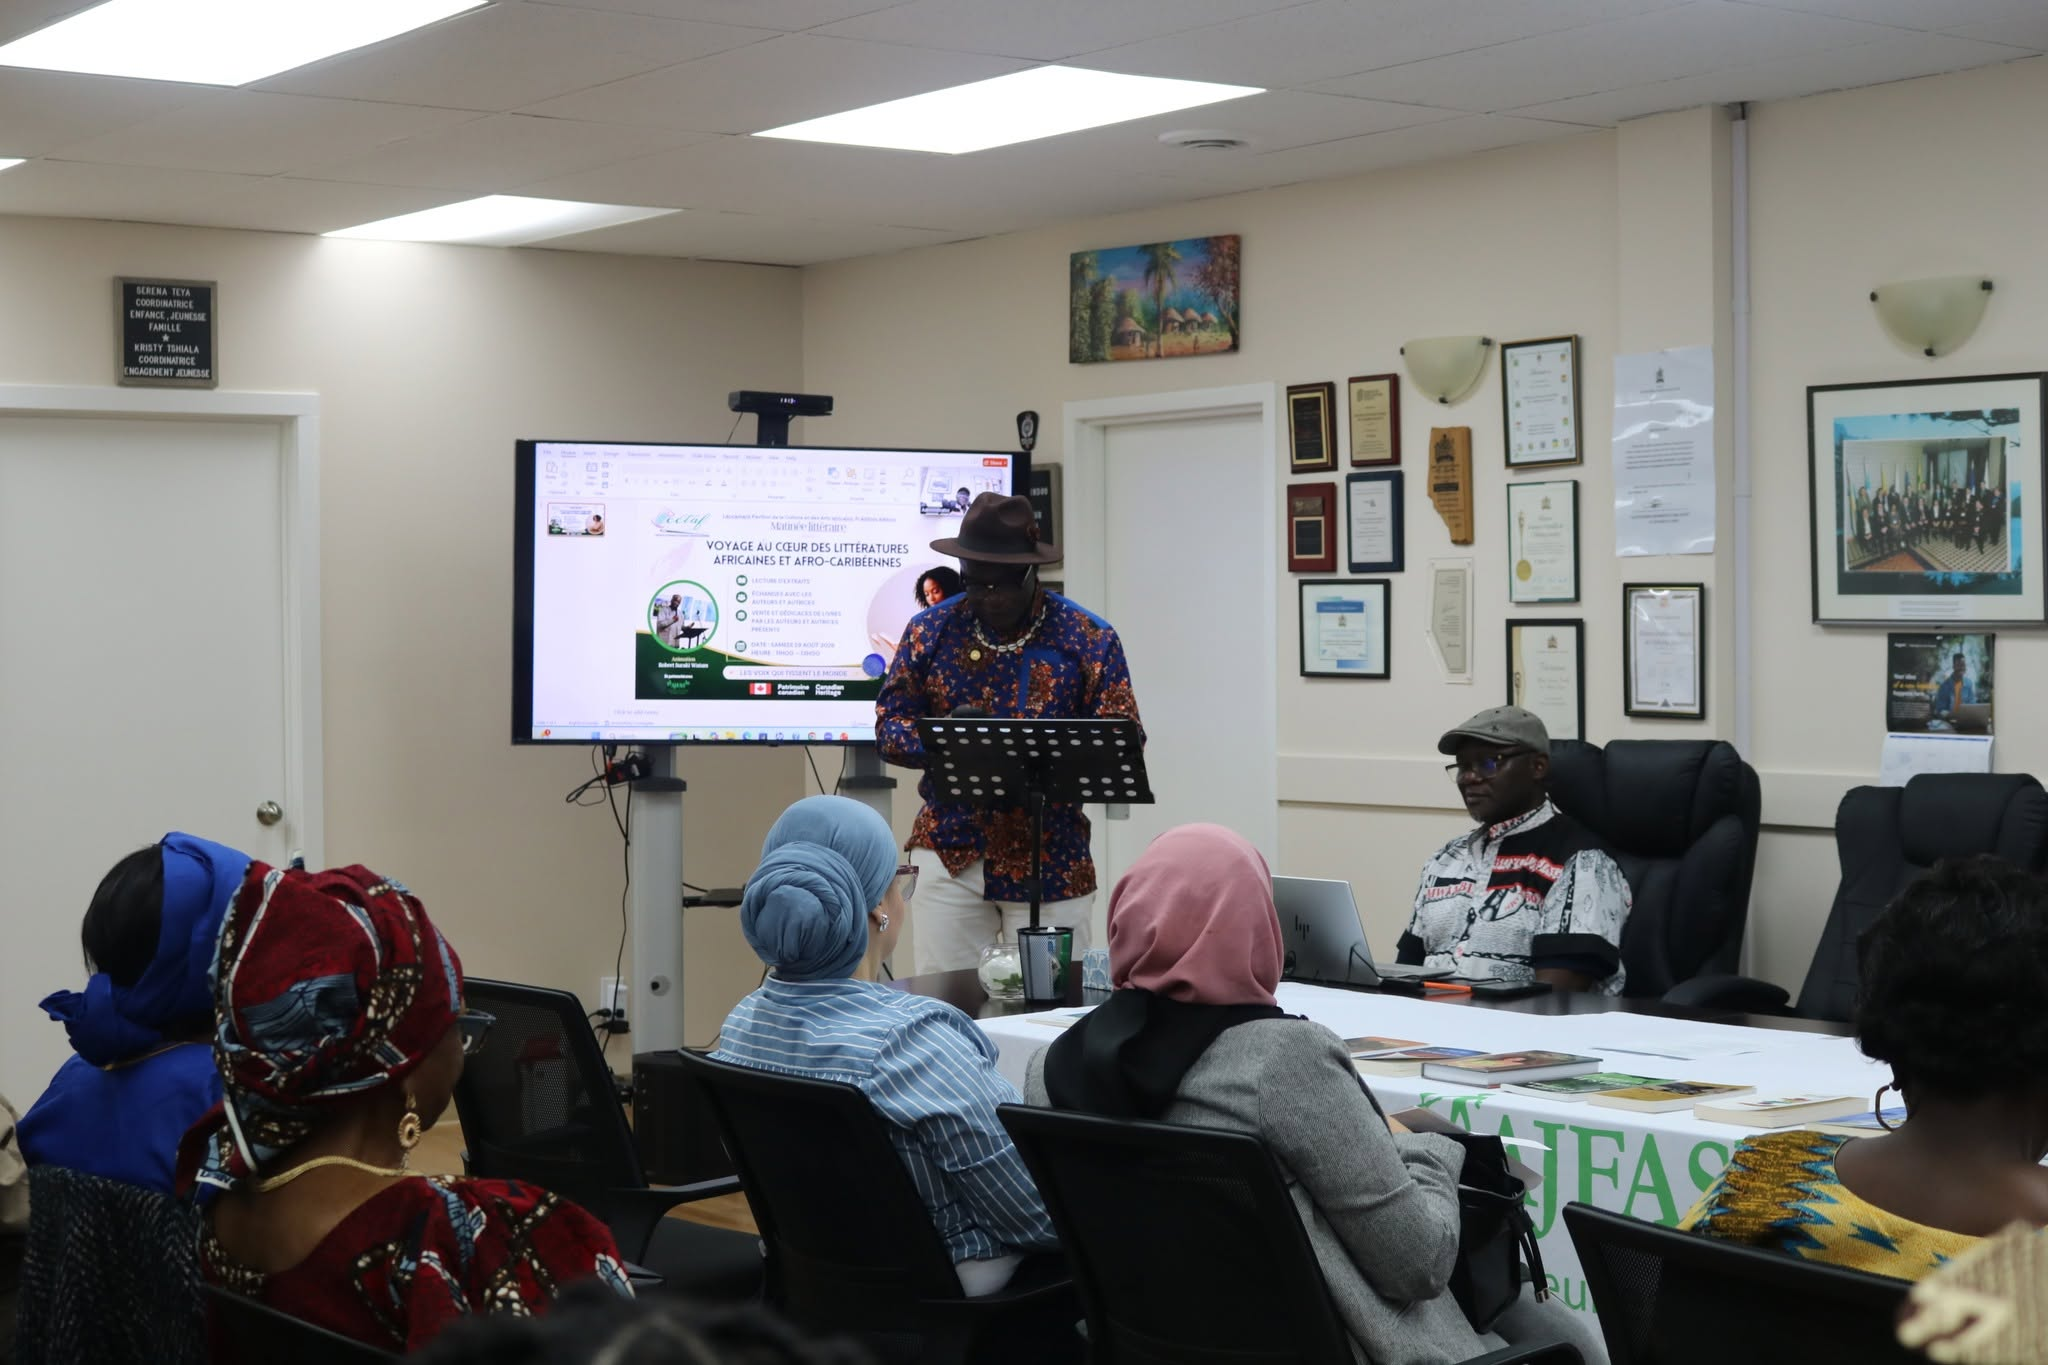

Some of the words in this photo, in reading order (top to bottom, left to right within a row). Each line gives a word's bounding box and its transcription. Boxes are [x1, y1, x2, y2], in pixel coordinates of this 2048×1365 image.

[136, 286, 168, 296] SERENA
[171, 287, 191, 297] TEYA
[135, 298, 194, 309] COORDINATRICE
[170, 312, 207, 321] JEUNESSE
[148, 322, 182, 332] FAMILLE
[134, 343, 163, 352] KRISTY
[166, 344, 200, 354] TSHIALA
[138, 355, 196, 366] COORDINATRICE
[124, 366, 173, 377] ENGAGEMENT
[175, 368, 211, 378] JEUNESSE
[706, 540, 754, 552] VOYAGE
[757, 541, 773, 552] AU
[775, 542, 808, 553] CŒUR
[811, 542, 831, 554] DES
[834, 541, 909, 555] LITTÉRATURES
[713, 555, 776, 567] AFRICAINES
[778, 556, 792, 567] ET
[794, 555, 902, 569] AFRO-CARIBÉENNES
[739, 669, 753, 677] LES
[815, 689, 841, 697] Heritage
